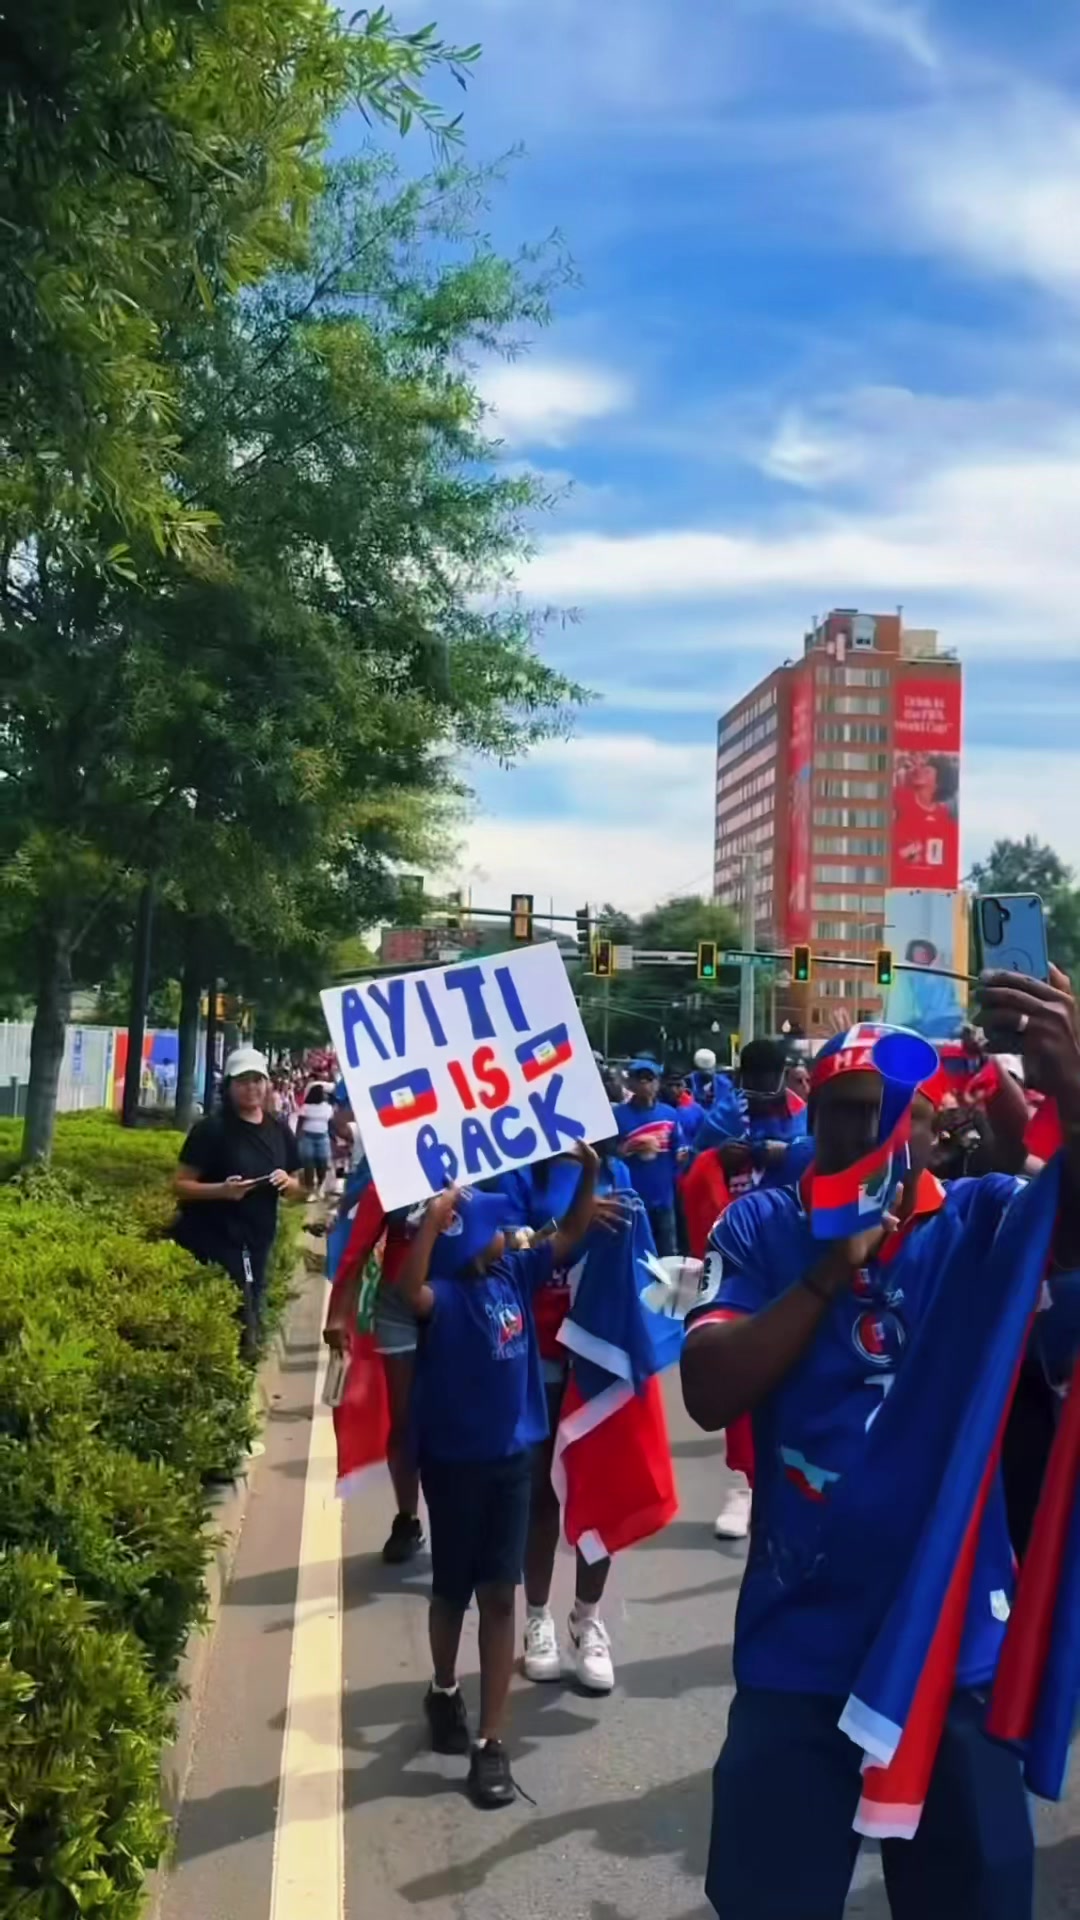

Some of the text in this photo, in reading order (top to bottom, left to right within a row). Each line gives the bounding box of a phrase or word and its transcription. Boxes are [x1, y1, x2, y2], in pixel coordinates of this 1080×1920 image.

[341, 965, 531, 1068] AYITI
[447, 1046, 510, 1110] IS
[416, 1073, 586, 1192] BACK
